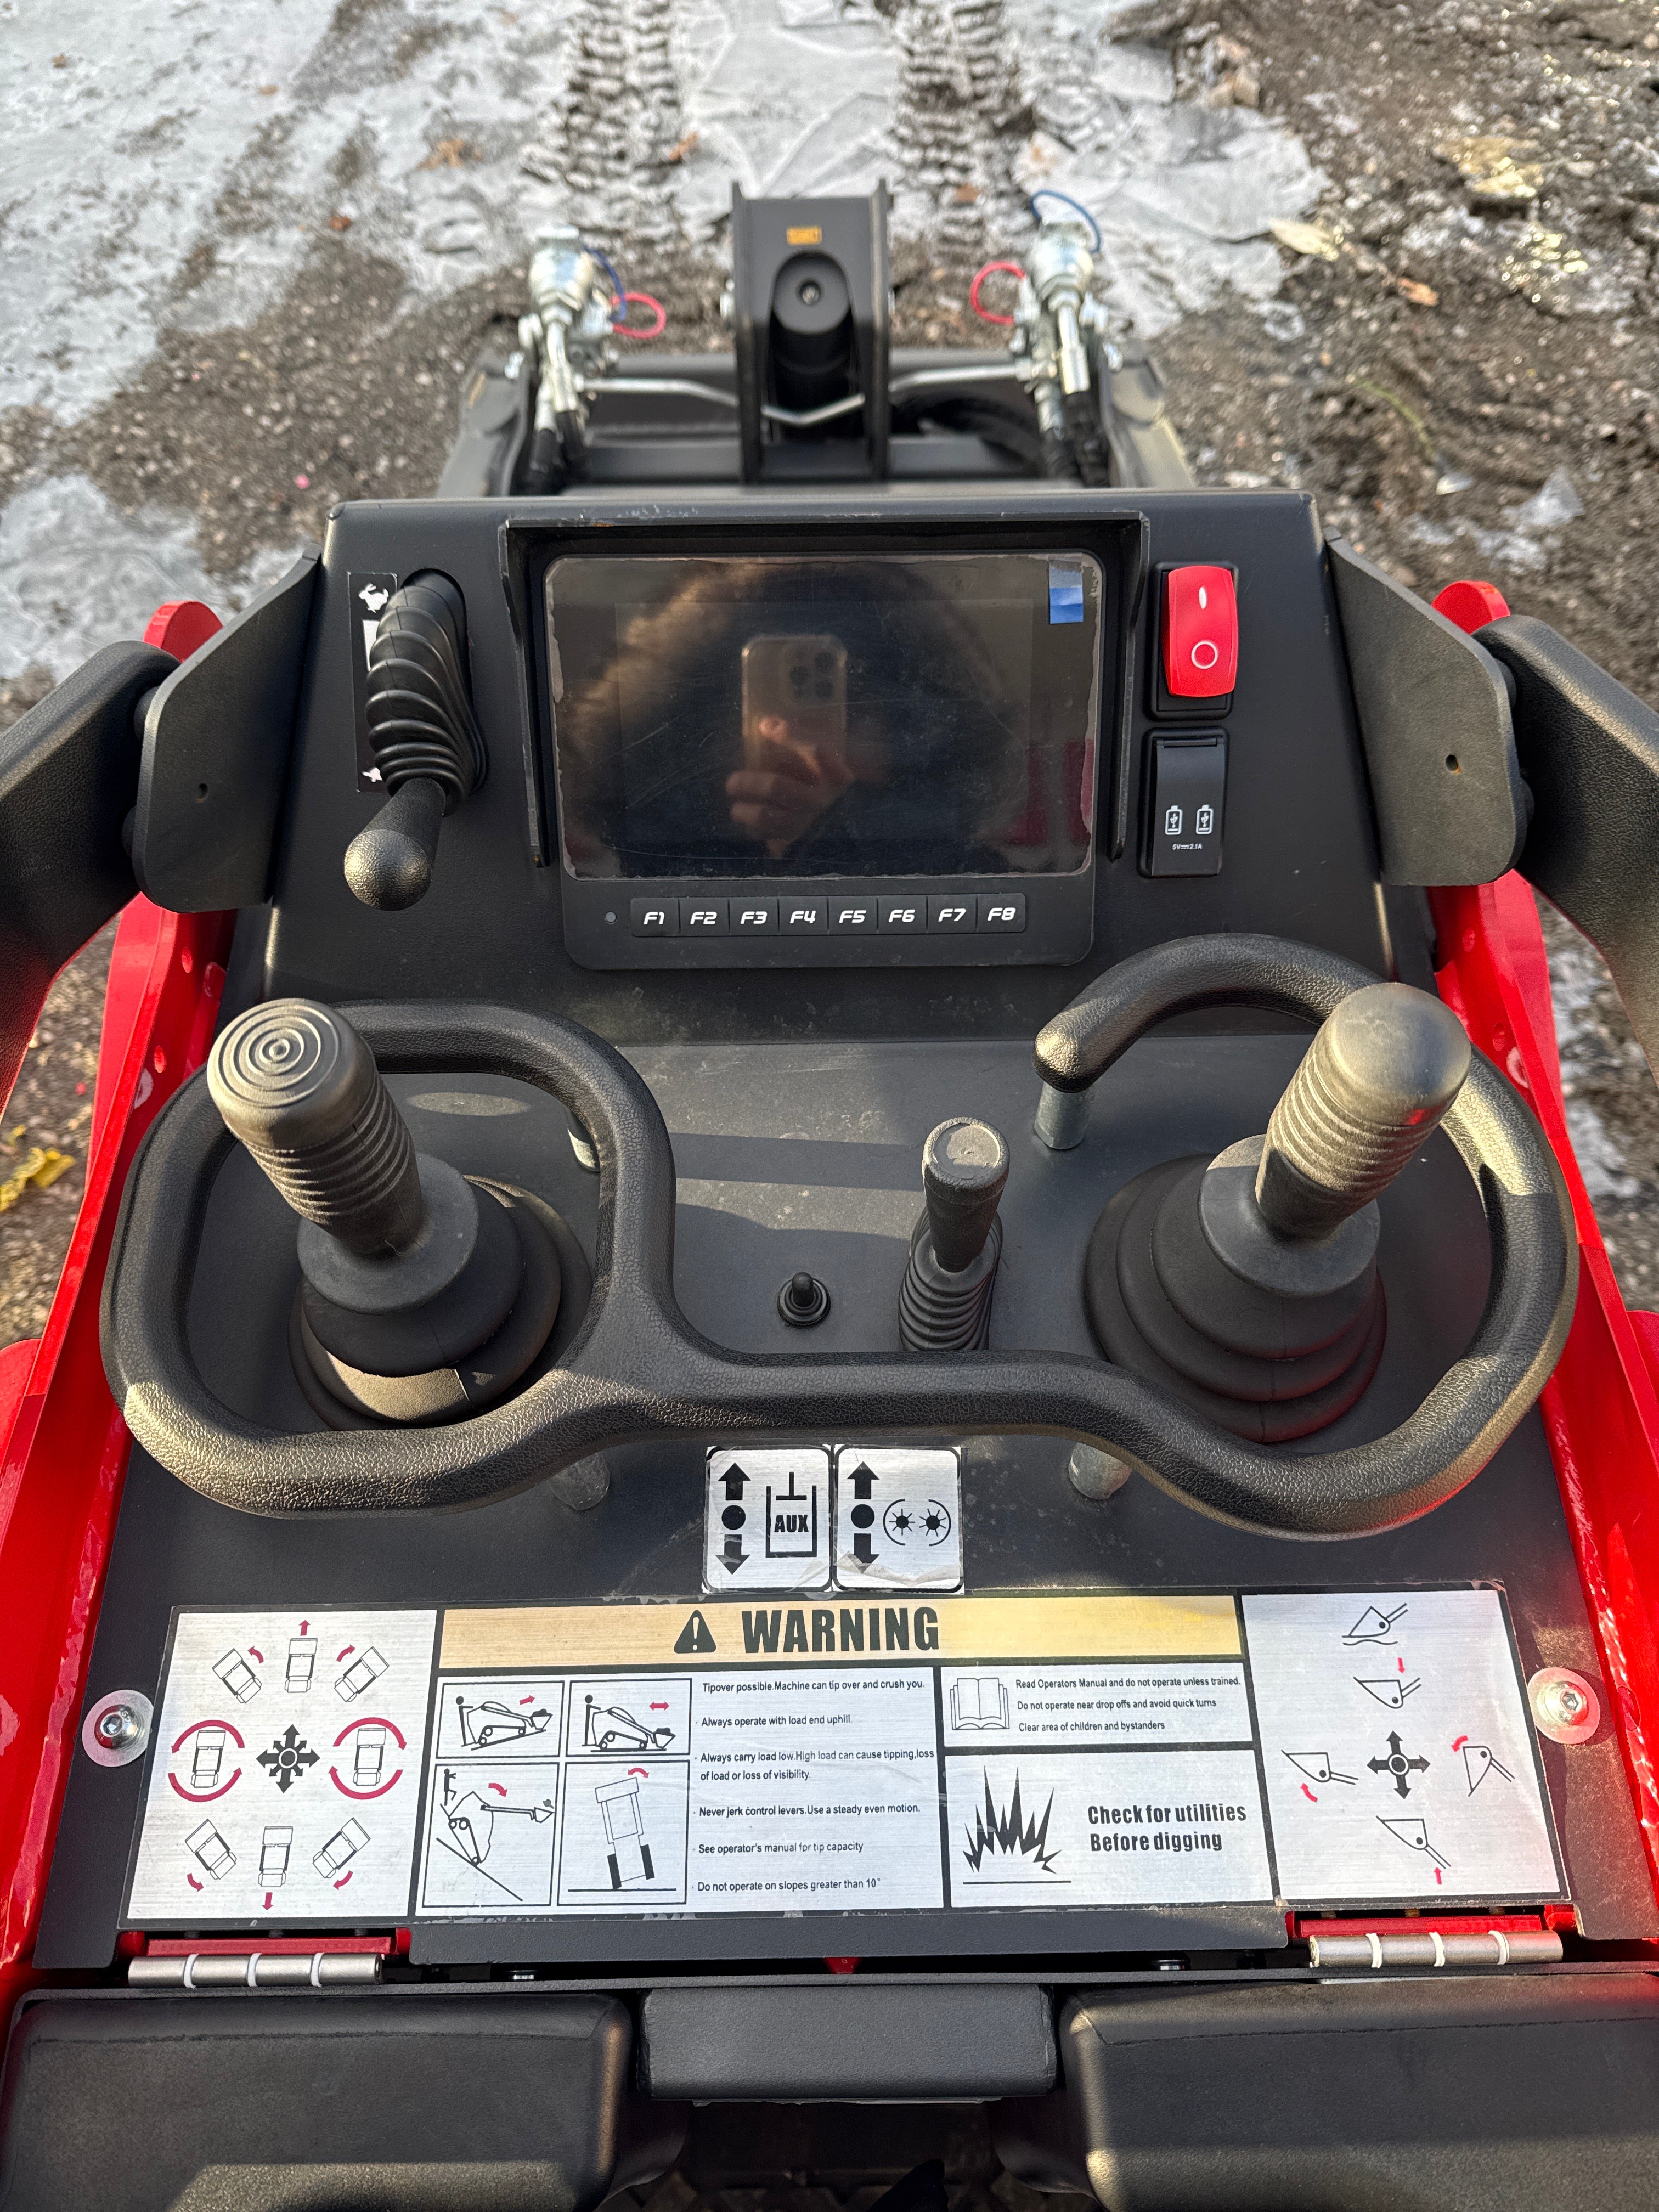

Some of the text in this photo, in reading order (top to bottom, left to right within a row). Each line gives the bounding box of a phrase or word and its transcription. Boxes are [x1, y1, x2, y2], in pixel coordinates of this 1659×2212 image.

[644, 907, 1016, 925] F1 F2 F3 F4 F5 F6 F7 F8
[774, 1514, 809, 1533] AUX
[741, 1606, 939, 1654] WARNING
[702, 1683, 735, 1694] Tipover
[828, 1680, 840, 1691] tip
[862, 1679, 878, 1689] and
[881, 1679, 905, 1689] crush
[906, 1680, 925, 1691] you.
[1015, 1676, 1241, 1690] Read Operators Manual and do not operate unless trained.
[1017, 1701, 1029, 1710] Do
[1030, 1701, 1043, 1710] not
[1045, 1701, 1075, 1712] operate
[1096, 1700, 1114, 1711] drop
[1116, 1699, 1131, 1709] offs
[1133, 1699, 1148, 1708] and
[1149, 1699, 1171, 1708] avoid
[1172, 1699, 1195, 1709] quick
[1195, 1699, 1217, 1707] turns
[701, 1717, 732, 1729] Always
[734, 1717, 766, 1728] operate
[769, 1716, 786, 1725] with
[788, 1716, 807, 1725] load
[809, 1715, 825, 1724] end
[1019, 1722, 1040, 1732] Clear
[1060, 1722, 1068, 1731] of
[1070, 1722, 1103, 1731] children
[1104, 1721, 1119, 1730] and
[1120, 1720, 1165, 1733] bystanders
[700, 1753, 732, 1764] Always
[733, 1754, 756, 1764] carry
[758, 1751, 776, 1762] load
[817, 1750, 836, 1760] load
[856, 1751, 882, 1759] cause
[700, 1770, 710, 1781] of
[711, 1771, 730, 1781] load
[743, 1770, 761, 1780] loss
[763, 1769, 772, 1780] of
[699, 1807, 725, 1816] Never
[726, 1806, 743, 1819] jerk
[745, 1805, 776, 1816] control
[833, 1804, 862, 1816] steady
[887, 1804, 921, 1813] motion.
[1088, 1803, 1246, 1825] Check for utilities
[698, 1842, 864, 1855] See operator's manual for tip capacity
[1090, 1831, 1222, 1852] Before digging
[698, 1882, 710, 1892] Do
[713, 1882, 727, 1891] not
[729, 1882, 763, 1893] operate
[778, 1881, 808, 1892] slopes
[810, 1880, 842, 1892] greater
[843, 1879, 864, 1888] than
